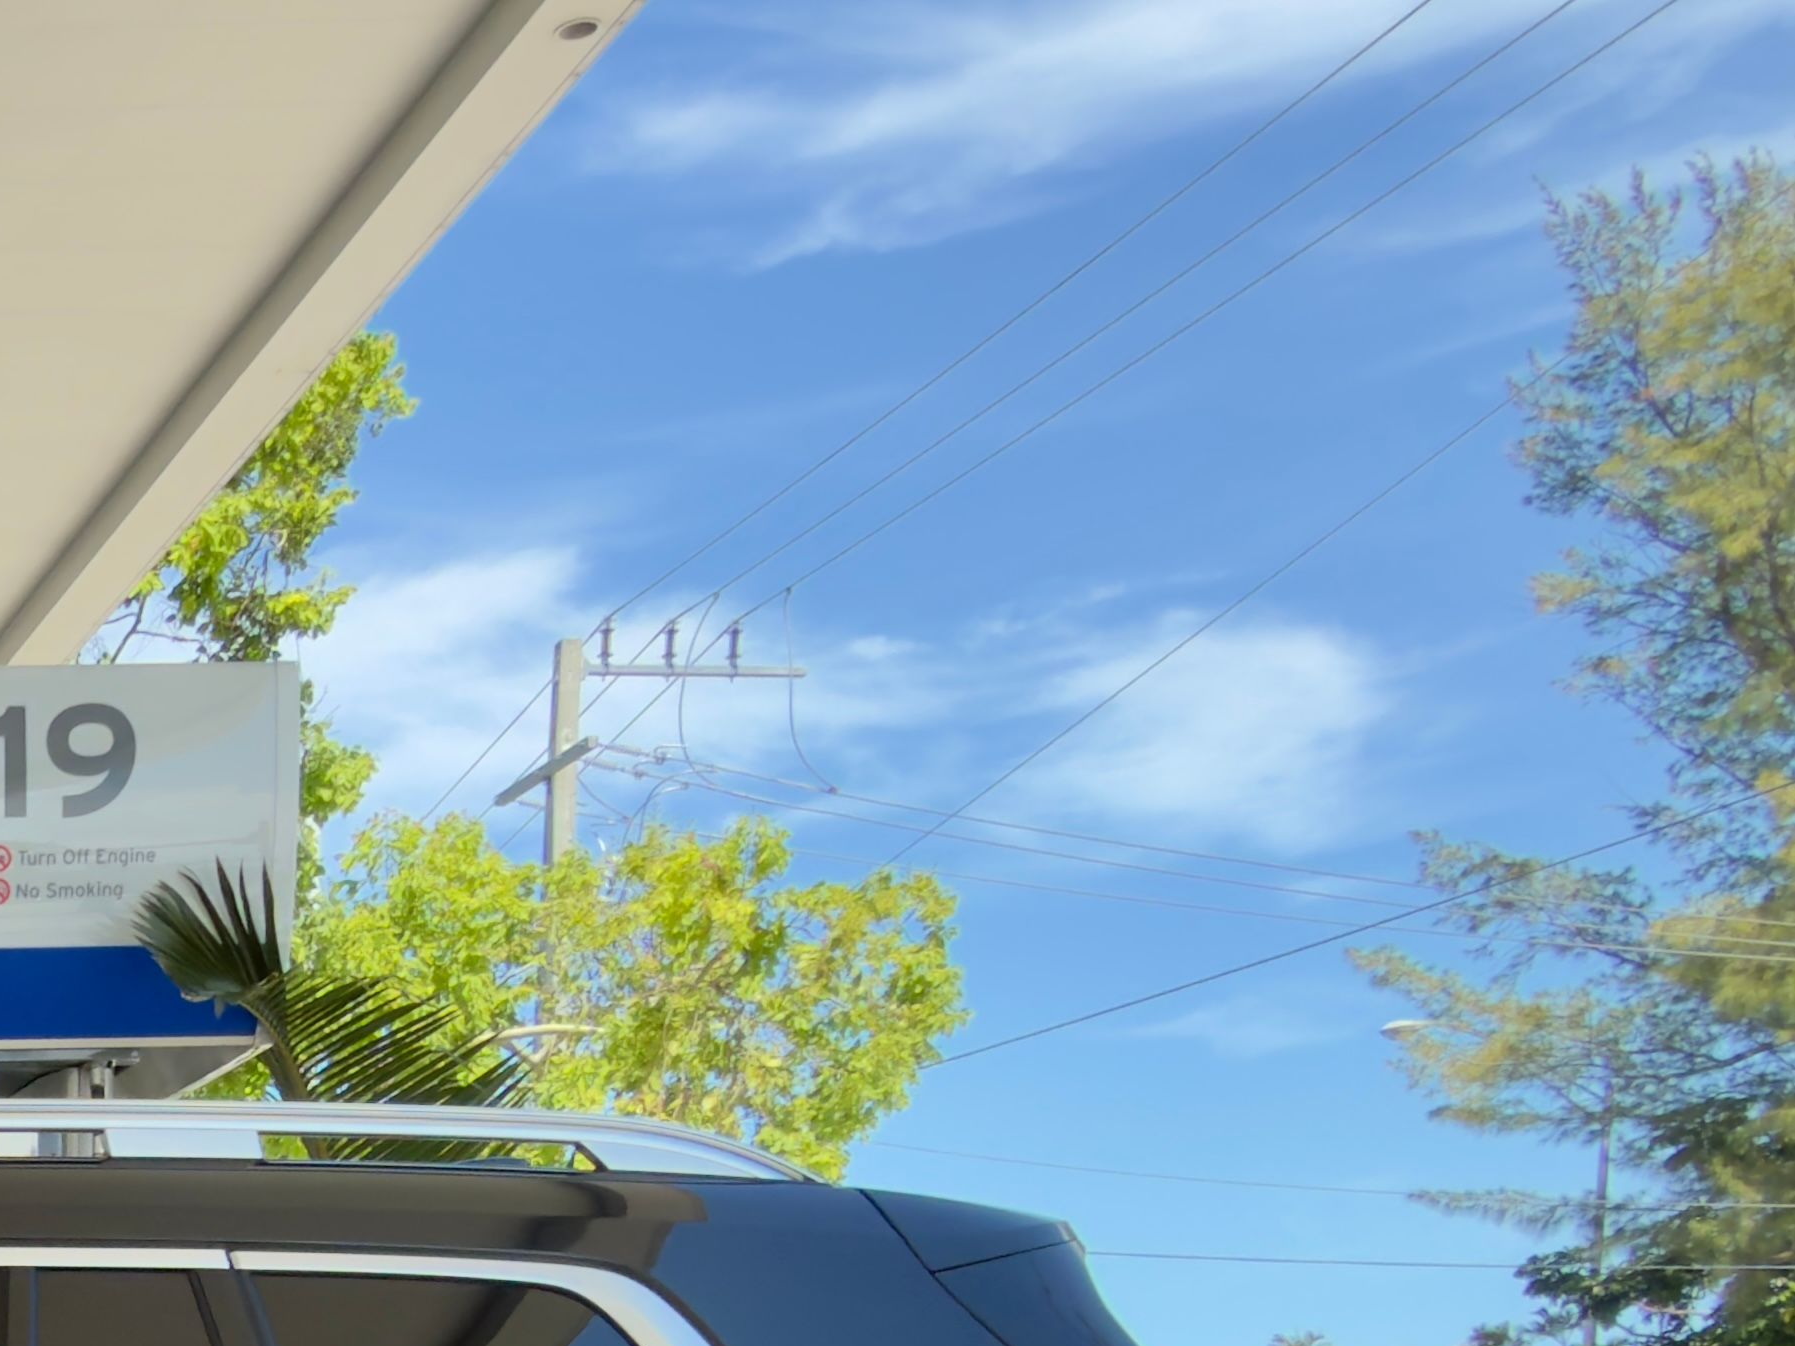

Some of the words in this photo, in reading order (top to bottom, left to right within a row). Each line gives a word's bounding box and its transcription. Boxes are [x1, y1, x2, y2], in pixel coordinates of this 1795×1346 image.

[18, 849, 57, 866] Turn
[62, 848, 90, 865] Off
[96, 847, 156, 867] Engine
[15, 883, 40, 898] No
[46, 881, 124, 900] Smoking
